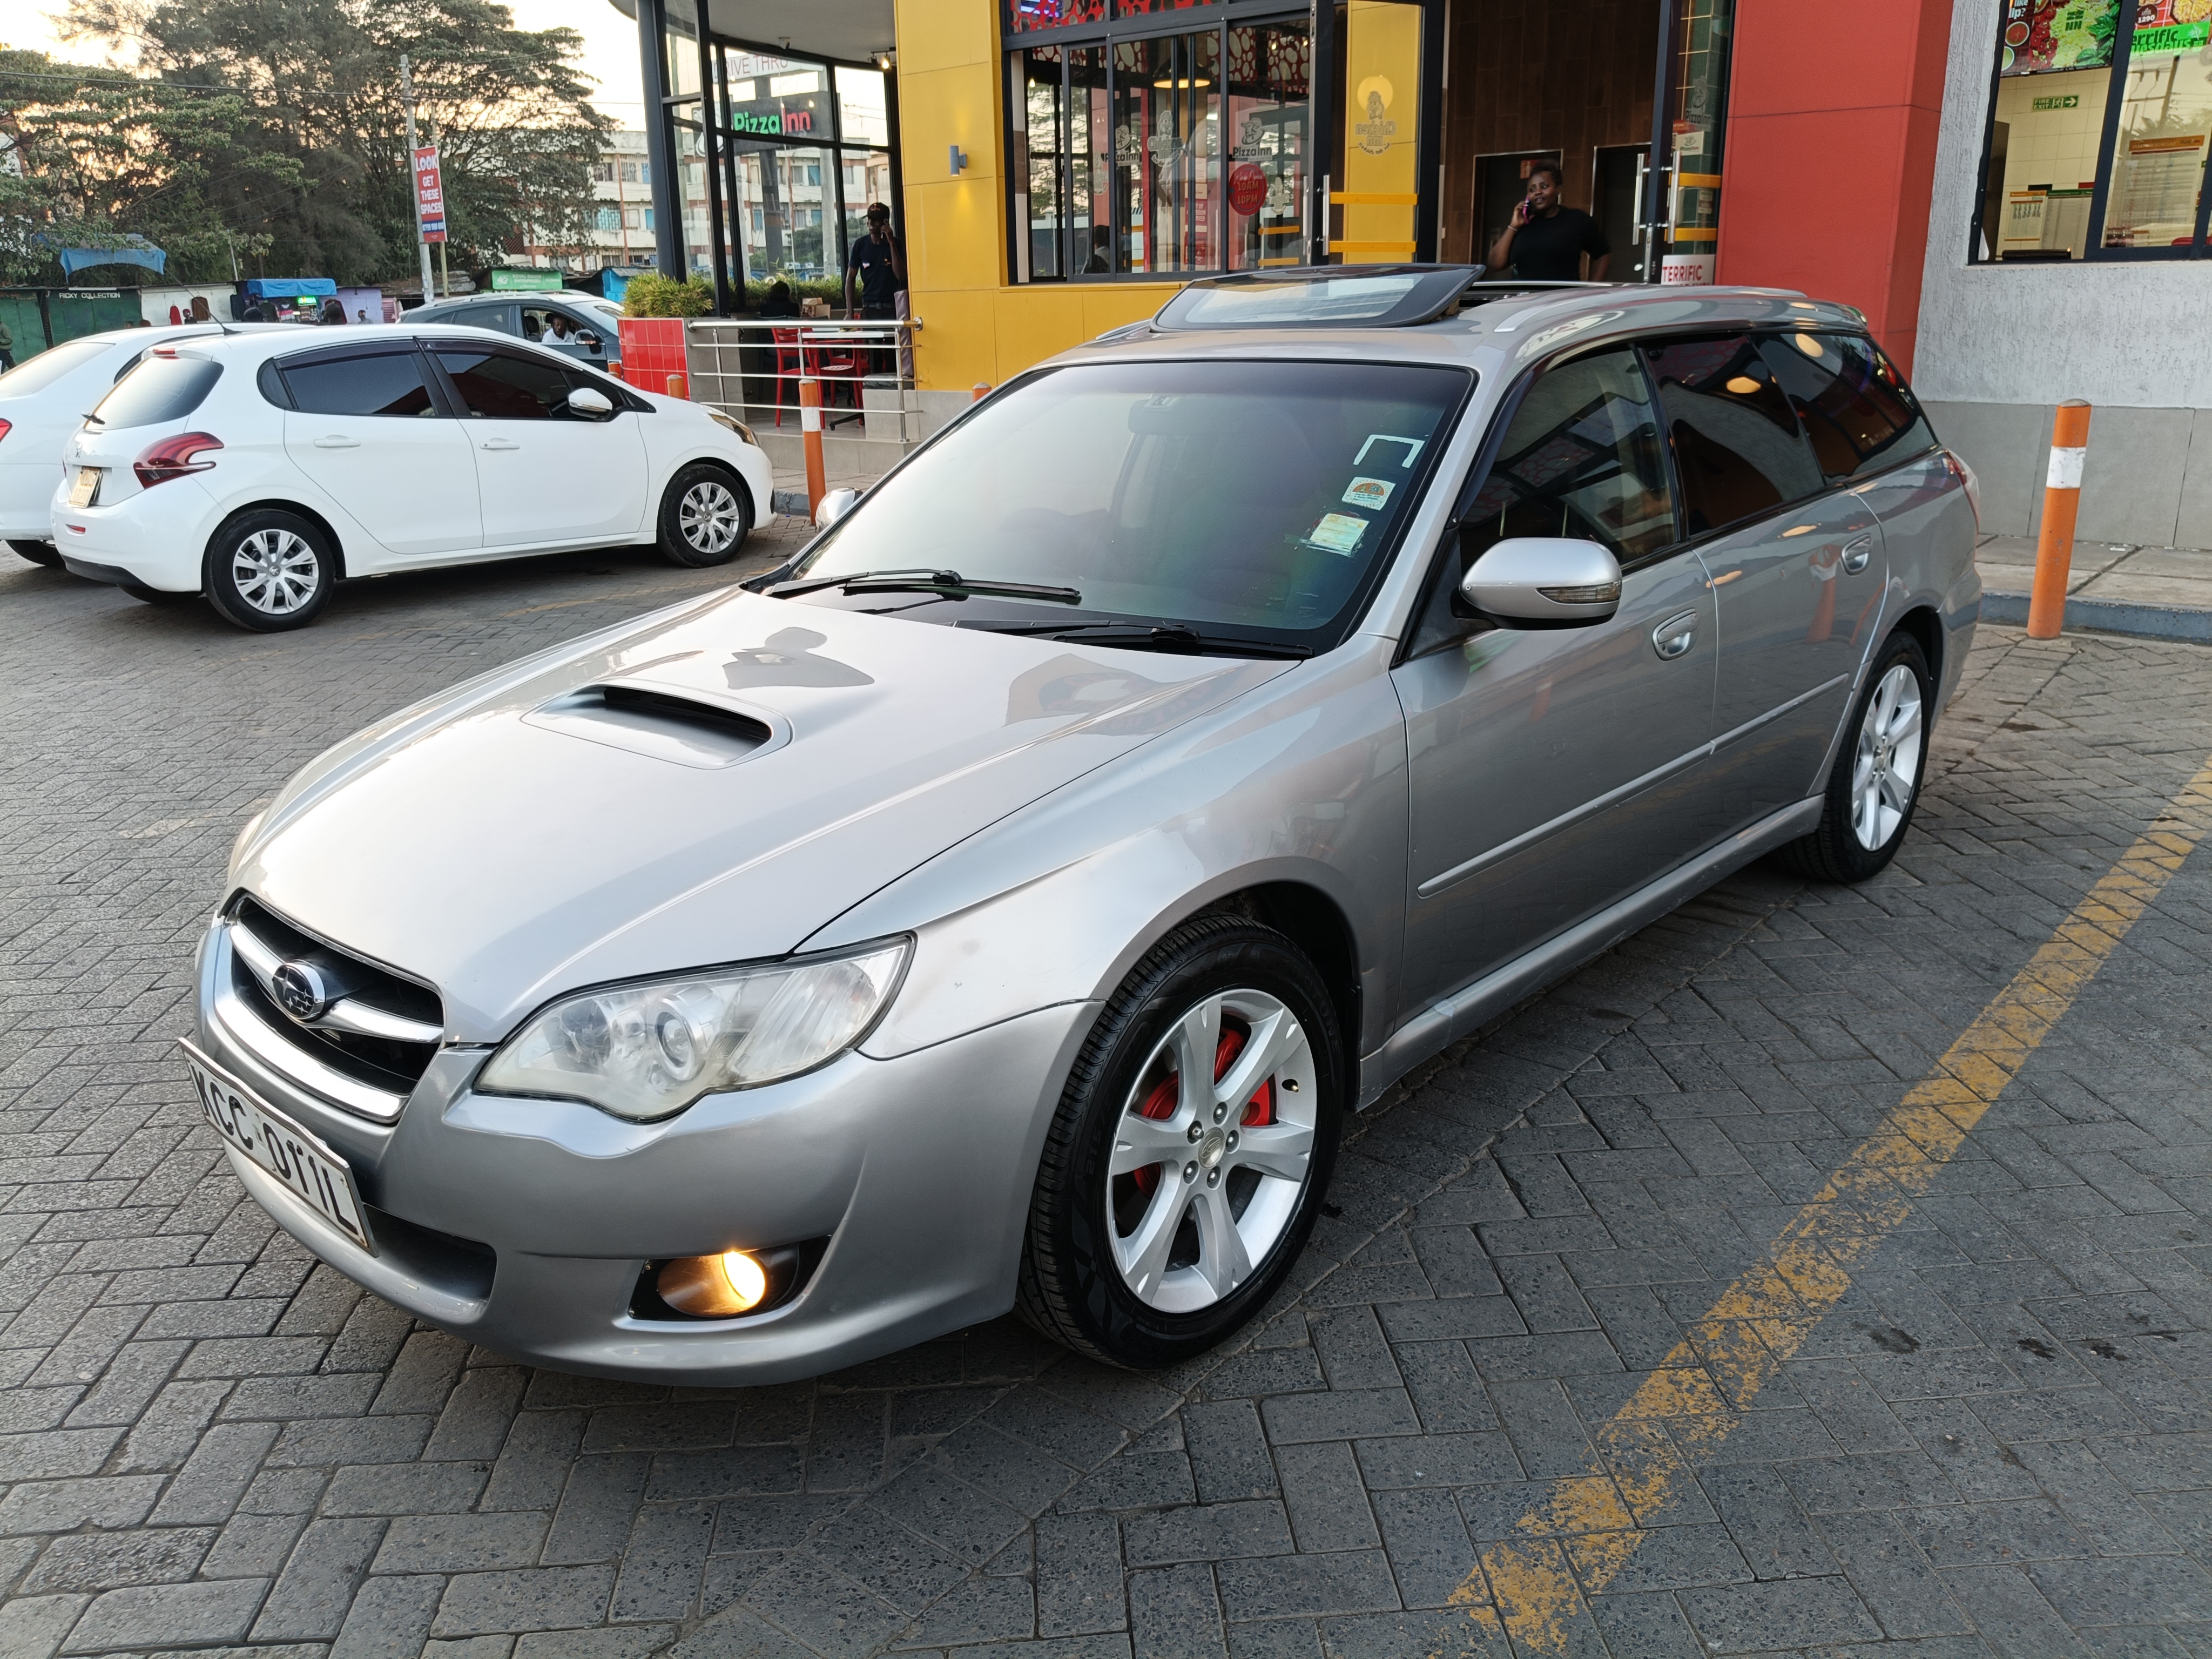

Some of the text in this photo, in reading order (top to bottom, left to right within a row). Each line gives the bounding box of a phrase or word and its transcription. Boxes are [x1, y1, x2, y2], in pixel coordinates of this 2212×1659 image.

[2137, 15, 2155, 23] 1290
[2133, 29, 2179, 44] errific
[2132, 40, 2191, 56] uesdays
[415, 154, 438, 172] LOOK
[422, 176, 434, 187] GET
[1238, 180, 1259, 191] 10AM
[420, 188, 439, 201] THESE
[1237, 195, 1258, 204] 10PM
[421, 202, 442, 214] SPACES
[1663, 265, 1703, 282] TERRIFIC
[191, 1064, 253, 1150] KCC
